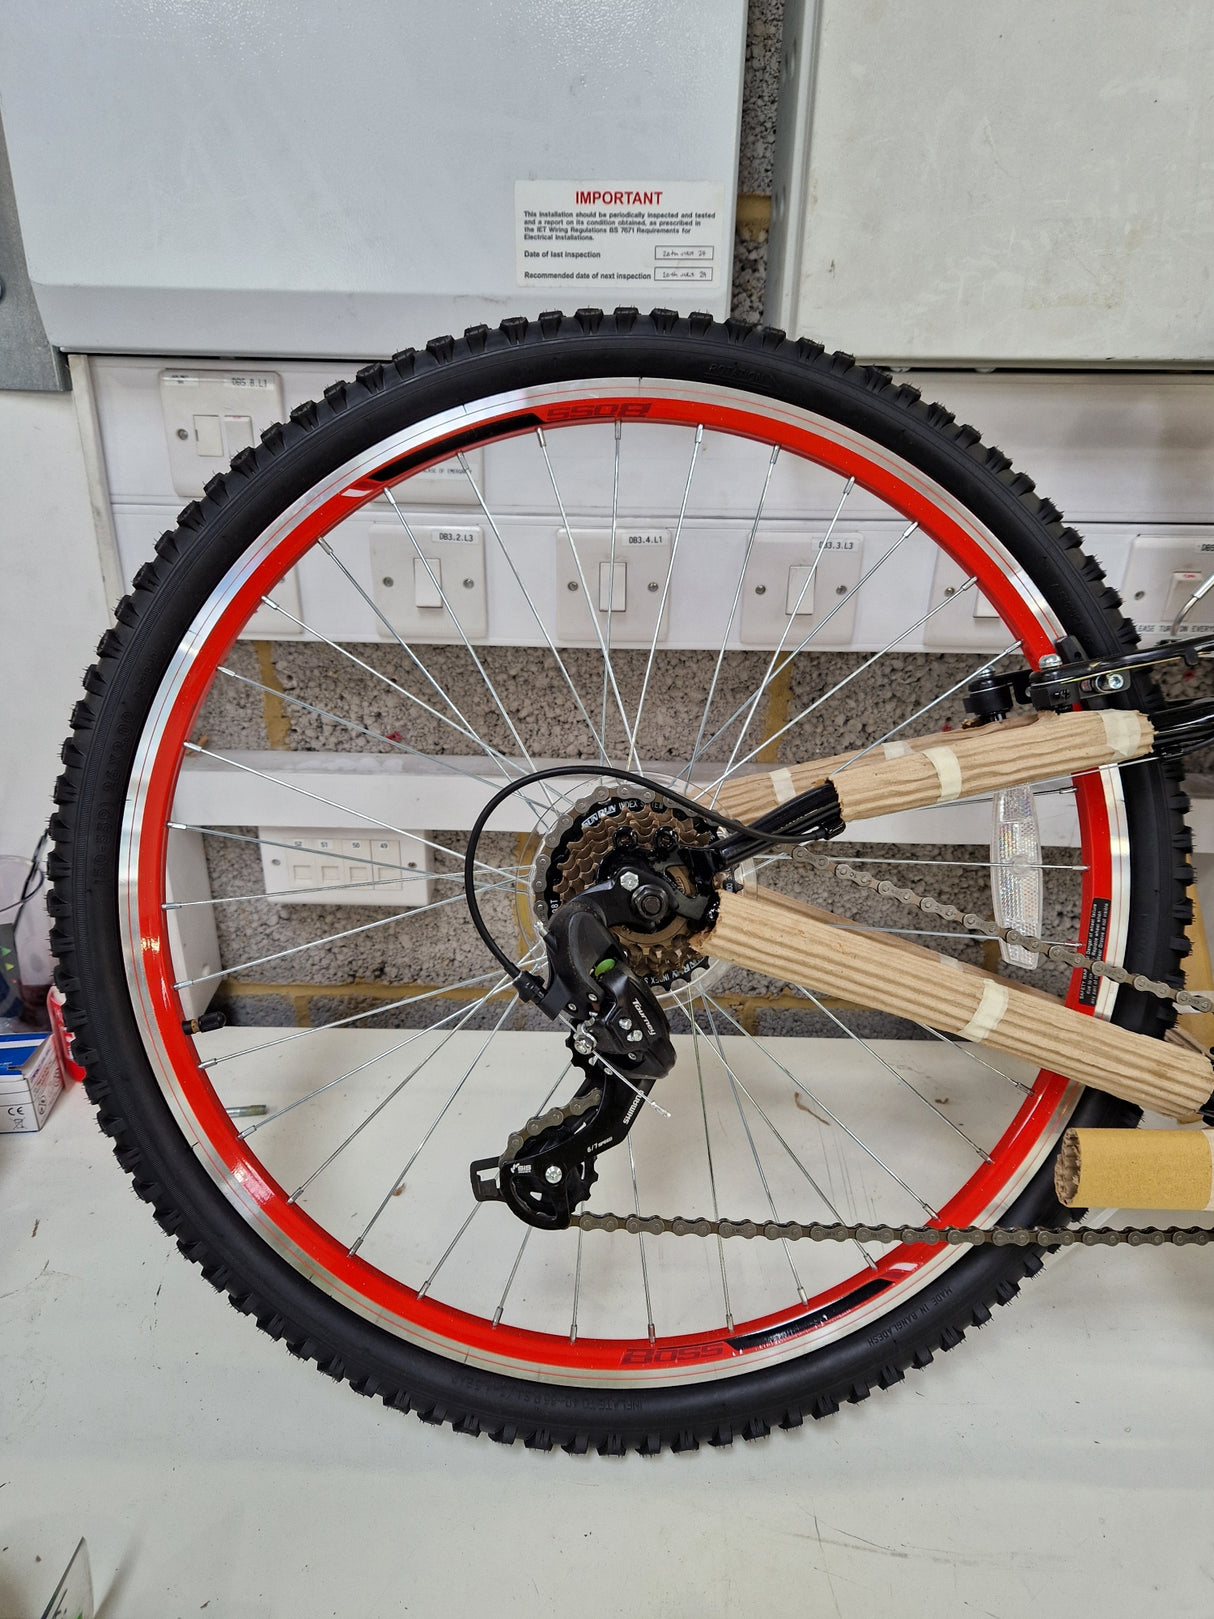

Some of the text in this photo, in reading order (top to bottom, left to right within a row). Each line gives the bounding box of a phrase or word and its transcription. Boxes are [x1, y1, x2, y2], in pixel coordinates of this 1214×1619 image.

[575, 191, 663, 206] IMPORTANT
[565, 251, 601, 259] inspection
[616, 272, 651, 280] inspection
[439, 532, 473, 542] DB3.2.L3
[629, 536, 662, 544] DB3.4.L1
[632, 998, 656, 1035] Tourney
[933, 1287, 953, 1306] MADE
[920, 1304, 929, 1314] IN
[619, 1343, 723, 1365] BOSS
